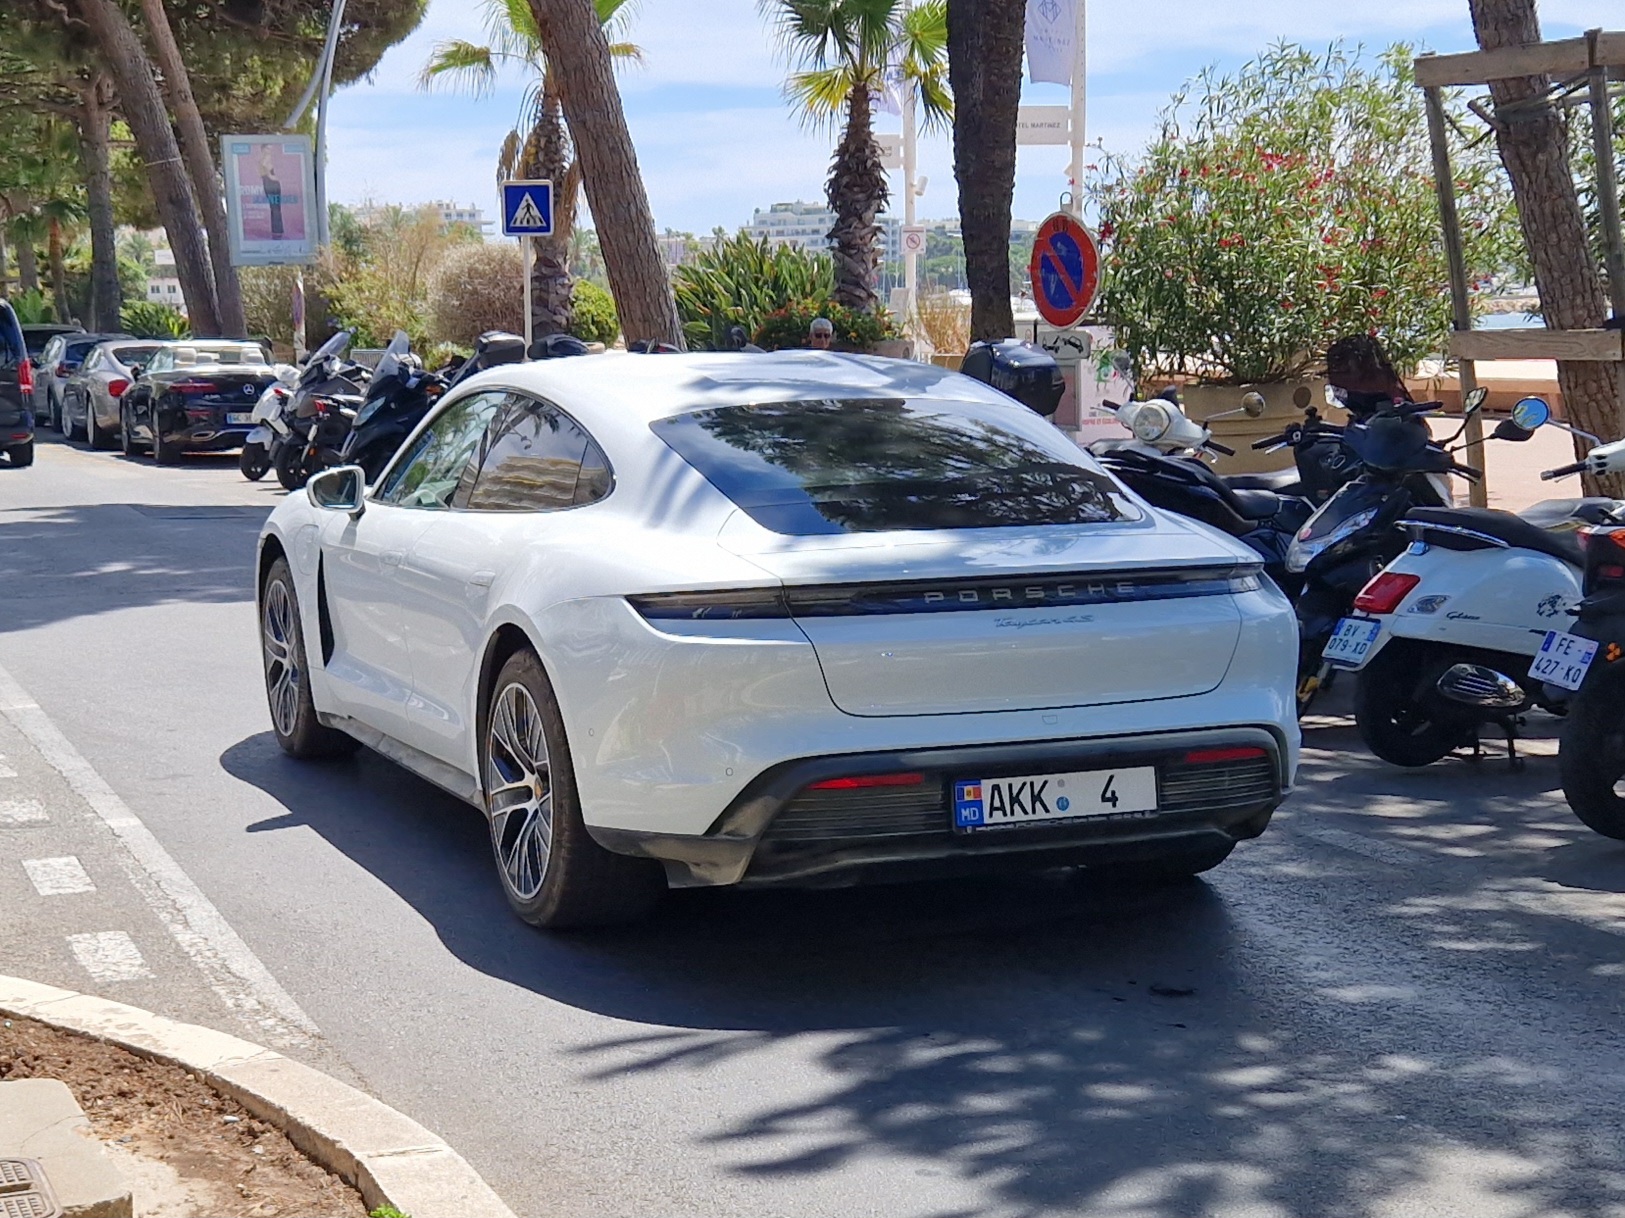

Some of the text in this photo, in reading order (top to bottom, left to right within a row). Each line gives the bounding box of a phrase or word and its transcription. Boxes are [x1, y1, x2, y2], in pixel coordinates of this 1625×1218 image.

[923, 581, 1136, 604] PORSCHE
[961, 774, 1119, 821] MD AKK 4
